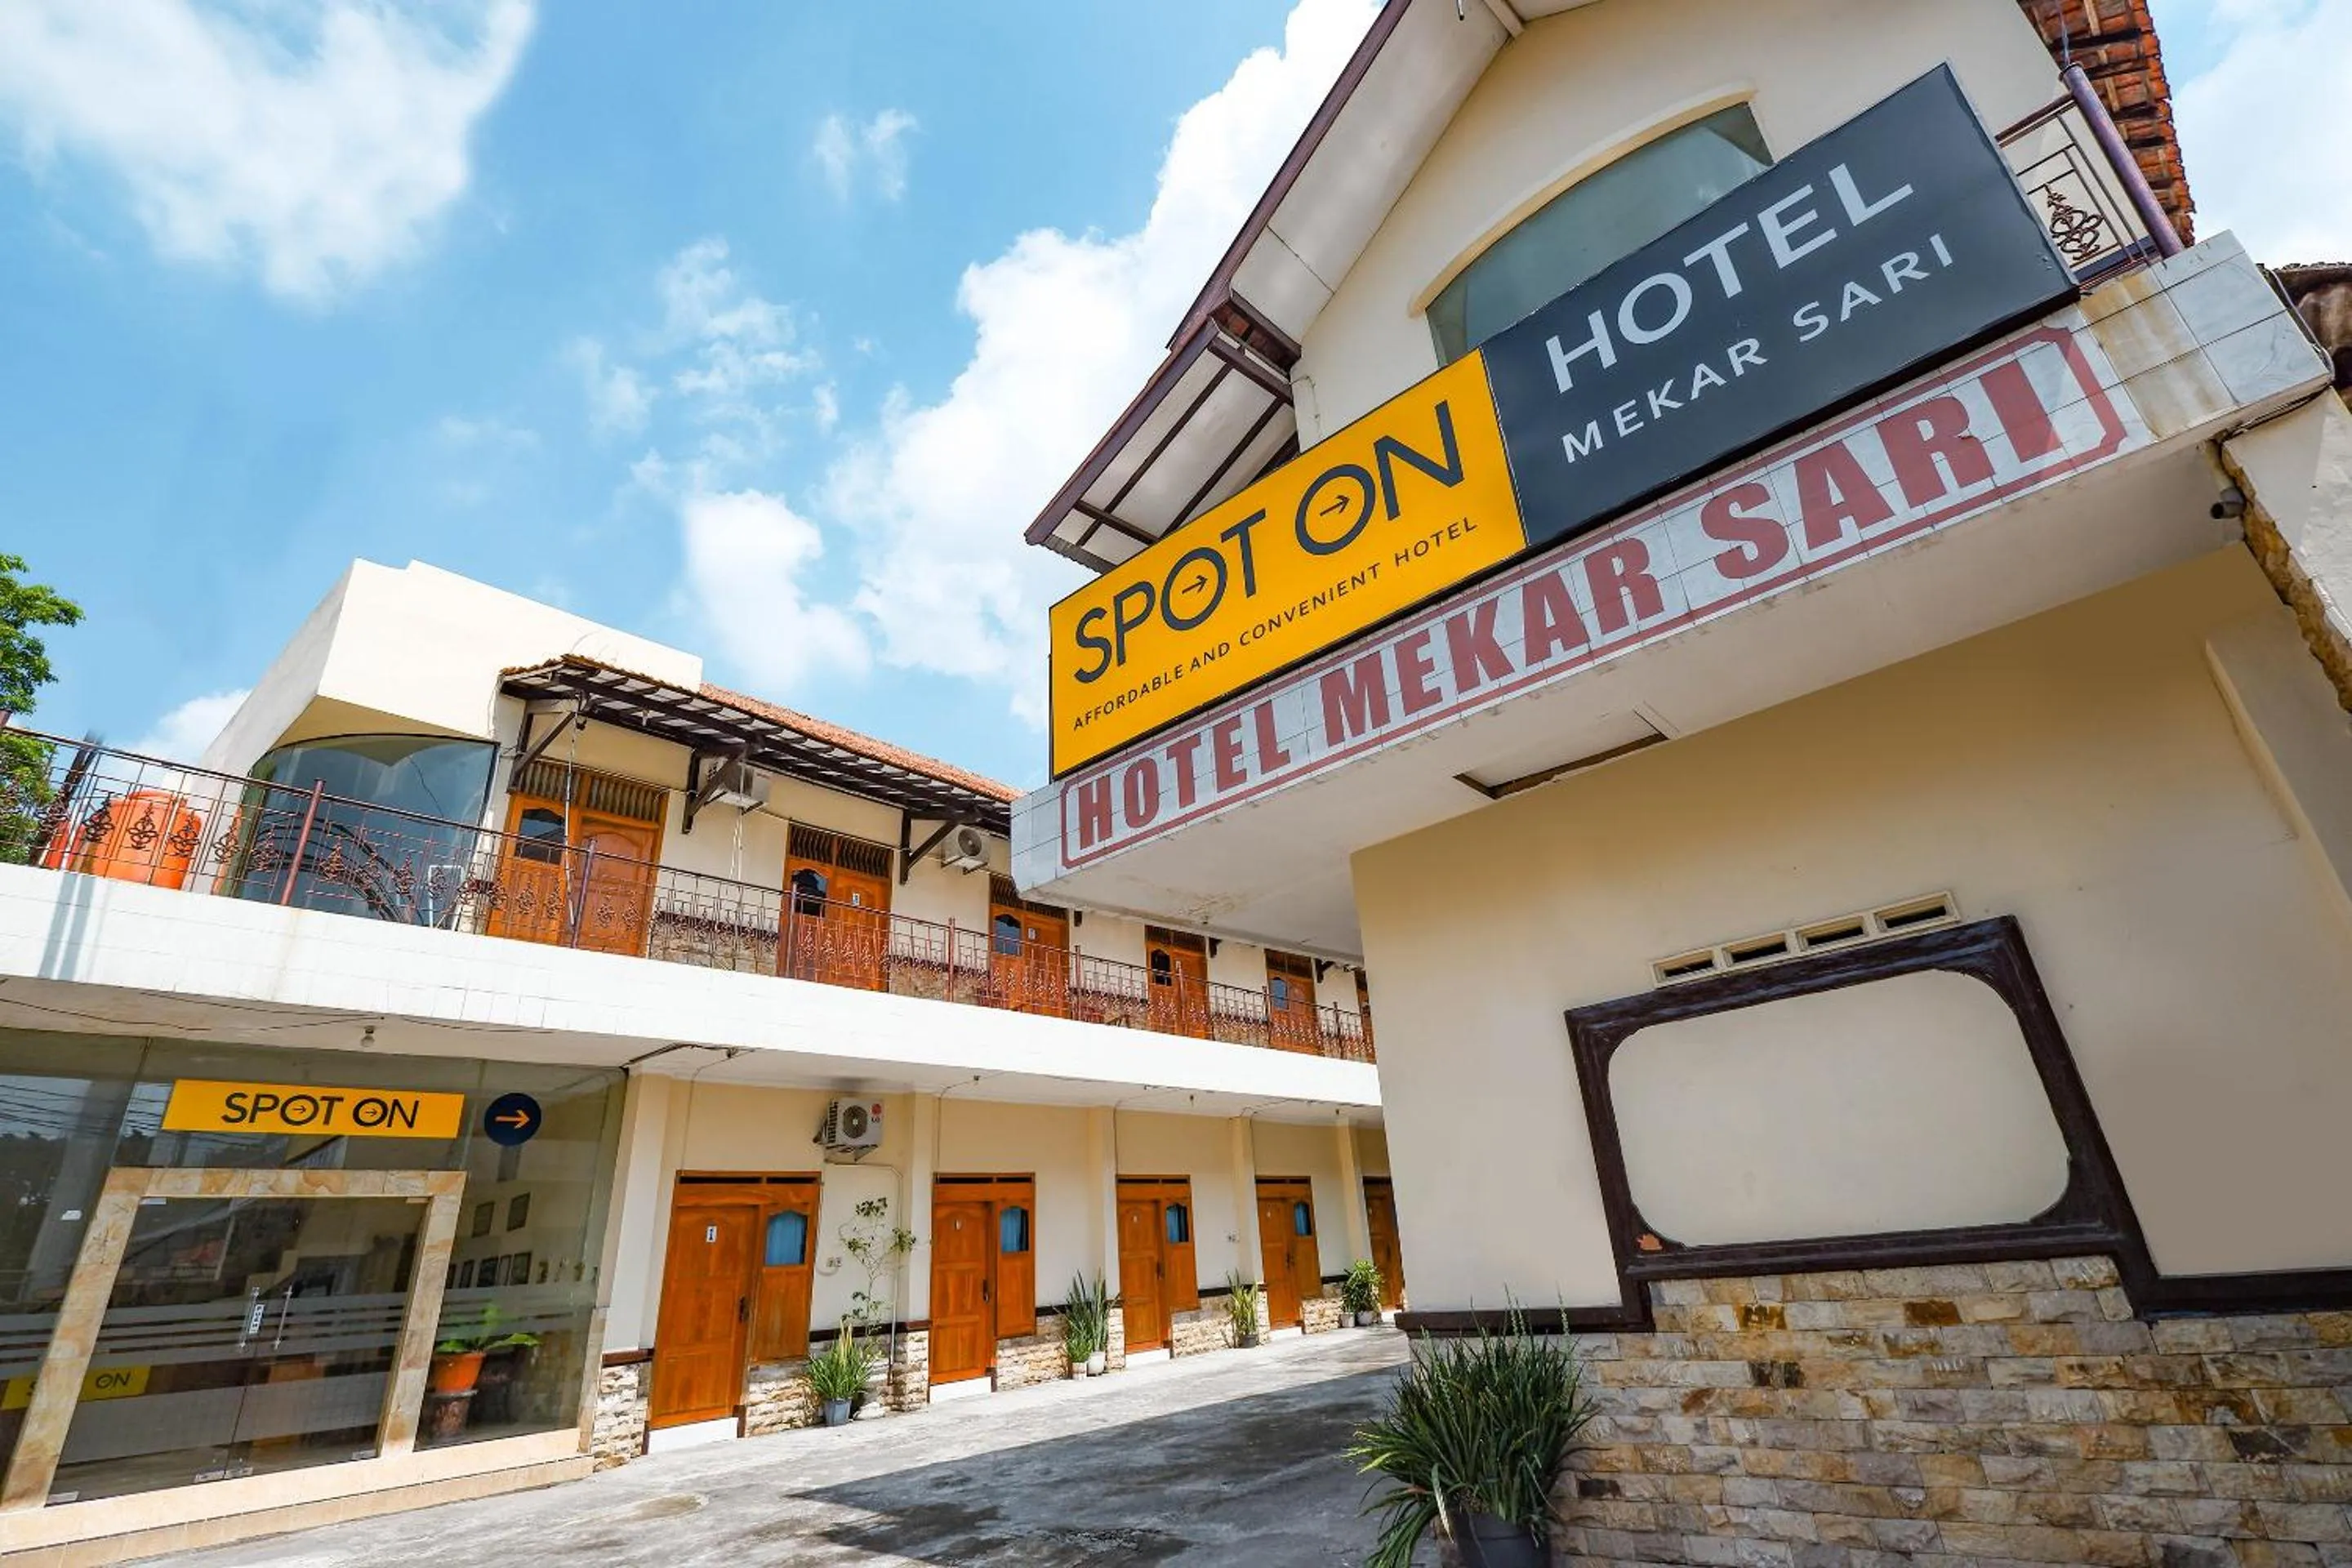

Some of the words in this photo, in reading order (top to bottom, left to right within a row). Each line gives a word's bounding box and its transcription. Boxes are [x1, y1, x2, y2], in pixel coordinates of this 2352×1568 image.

[1545, 163, 1913, 394] HOTEL
[1561, 337, 1767, 463] MEKAR
[1793, 233, 1955, 342] SARI
[1073, 665, 1183, 730] AFFORDABLE
[1189, 641, 1230, 674] AND
[1238, 562, 1381, 647] CONVENIENT
[1393, 516, 1477, 568] HOTEL
[1074, 508, 1267, 684] SPOT
[1294, 399, 1464, 555] ON
[1078, 700, 1291, 850] HOTEL
[1319, 537, 1664, 749] MEKAR
[1699, 359, 2063, 580] SARI
[221, 1092, 344, 1126] SPOT
[353, 1098, 420, 1129] ON
[95, 1372, 131, 1389] ON
